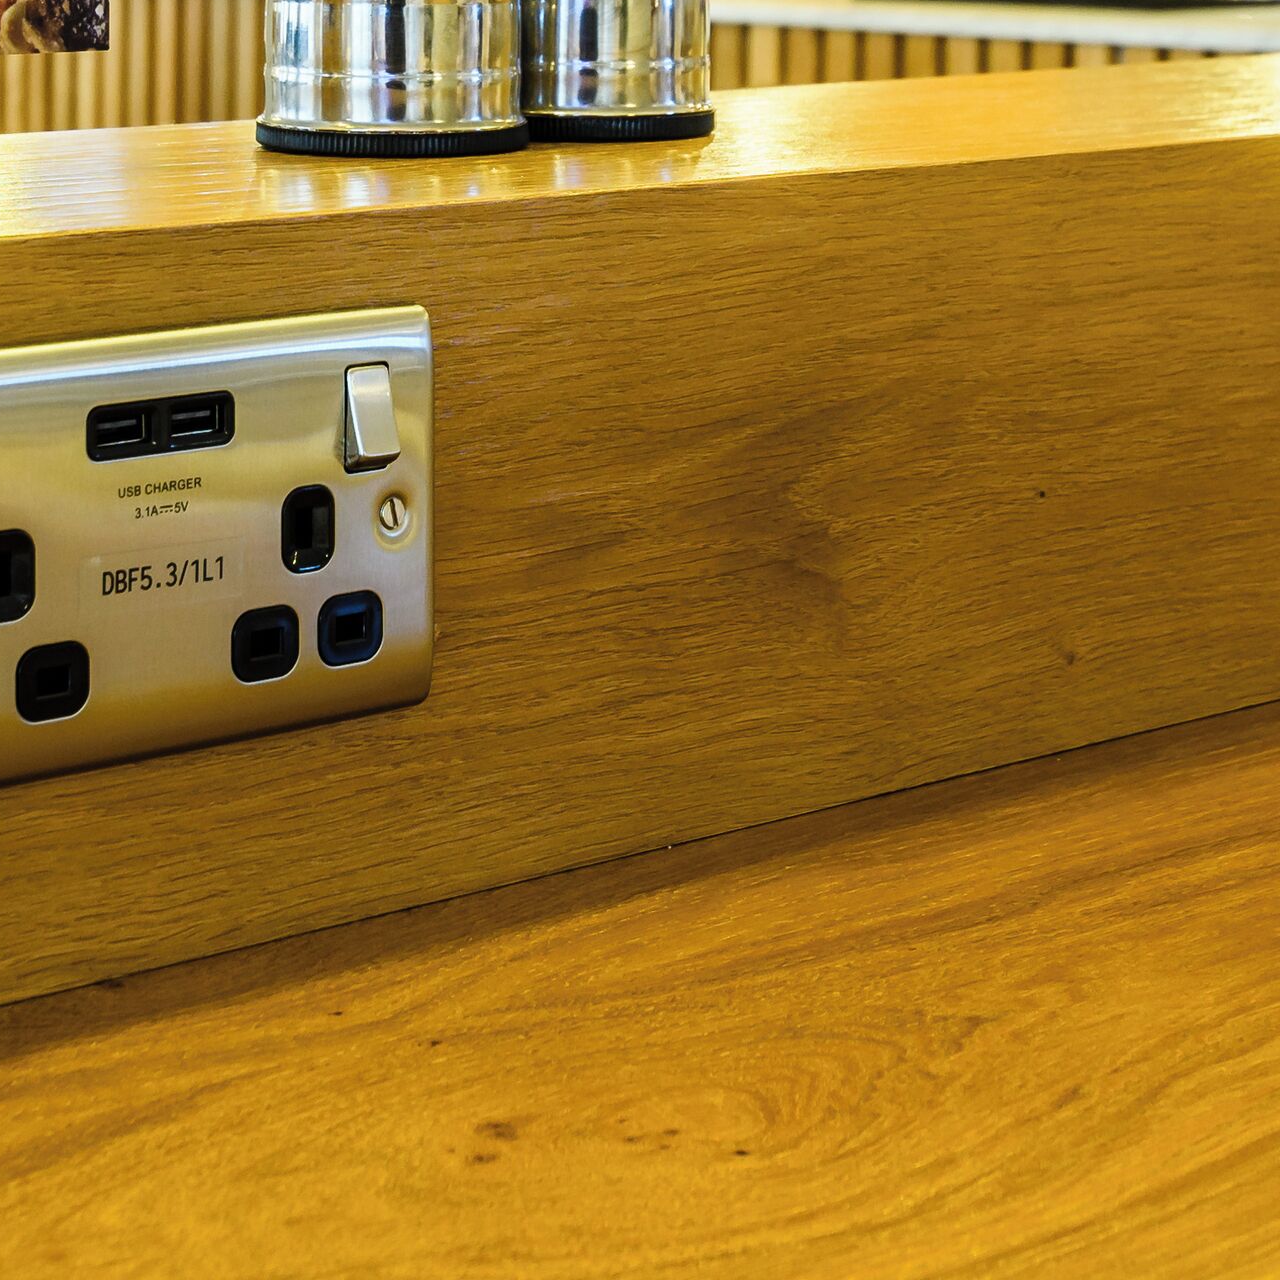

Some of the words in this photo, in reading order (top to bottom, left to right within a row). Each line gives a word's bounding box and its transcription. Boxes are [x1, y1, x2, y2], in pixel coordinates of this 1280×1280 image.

[117, 484, 142, 499] USB
[144, 476, 202, 496] CHARGER
[101, 556, 224, 596] DBF5.3/1L1
